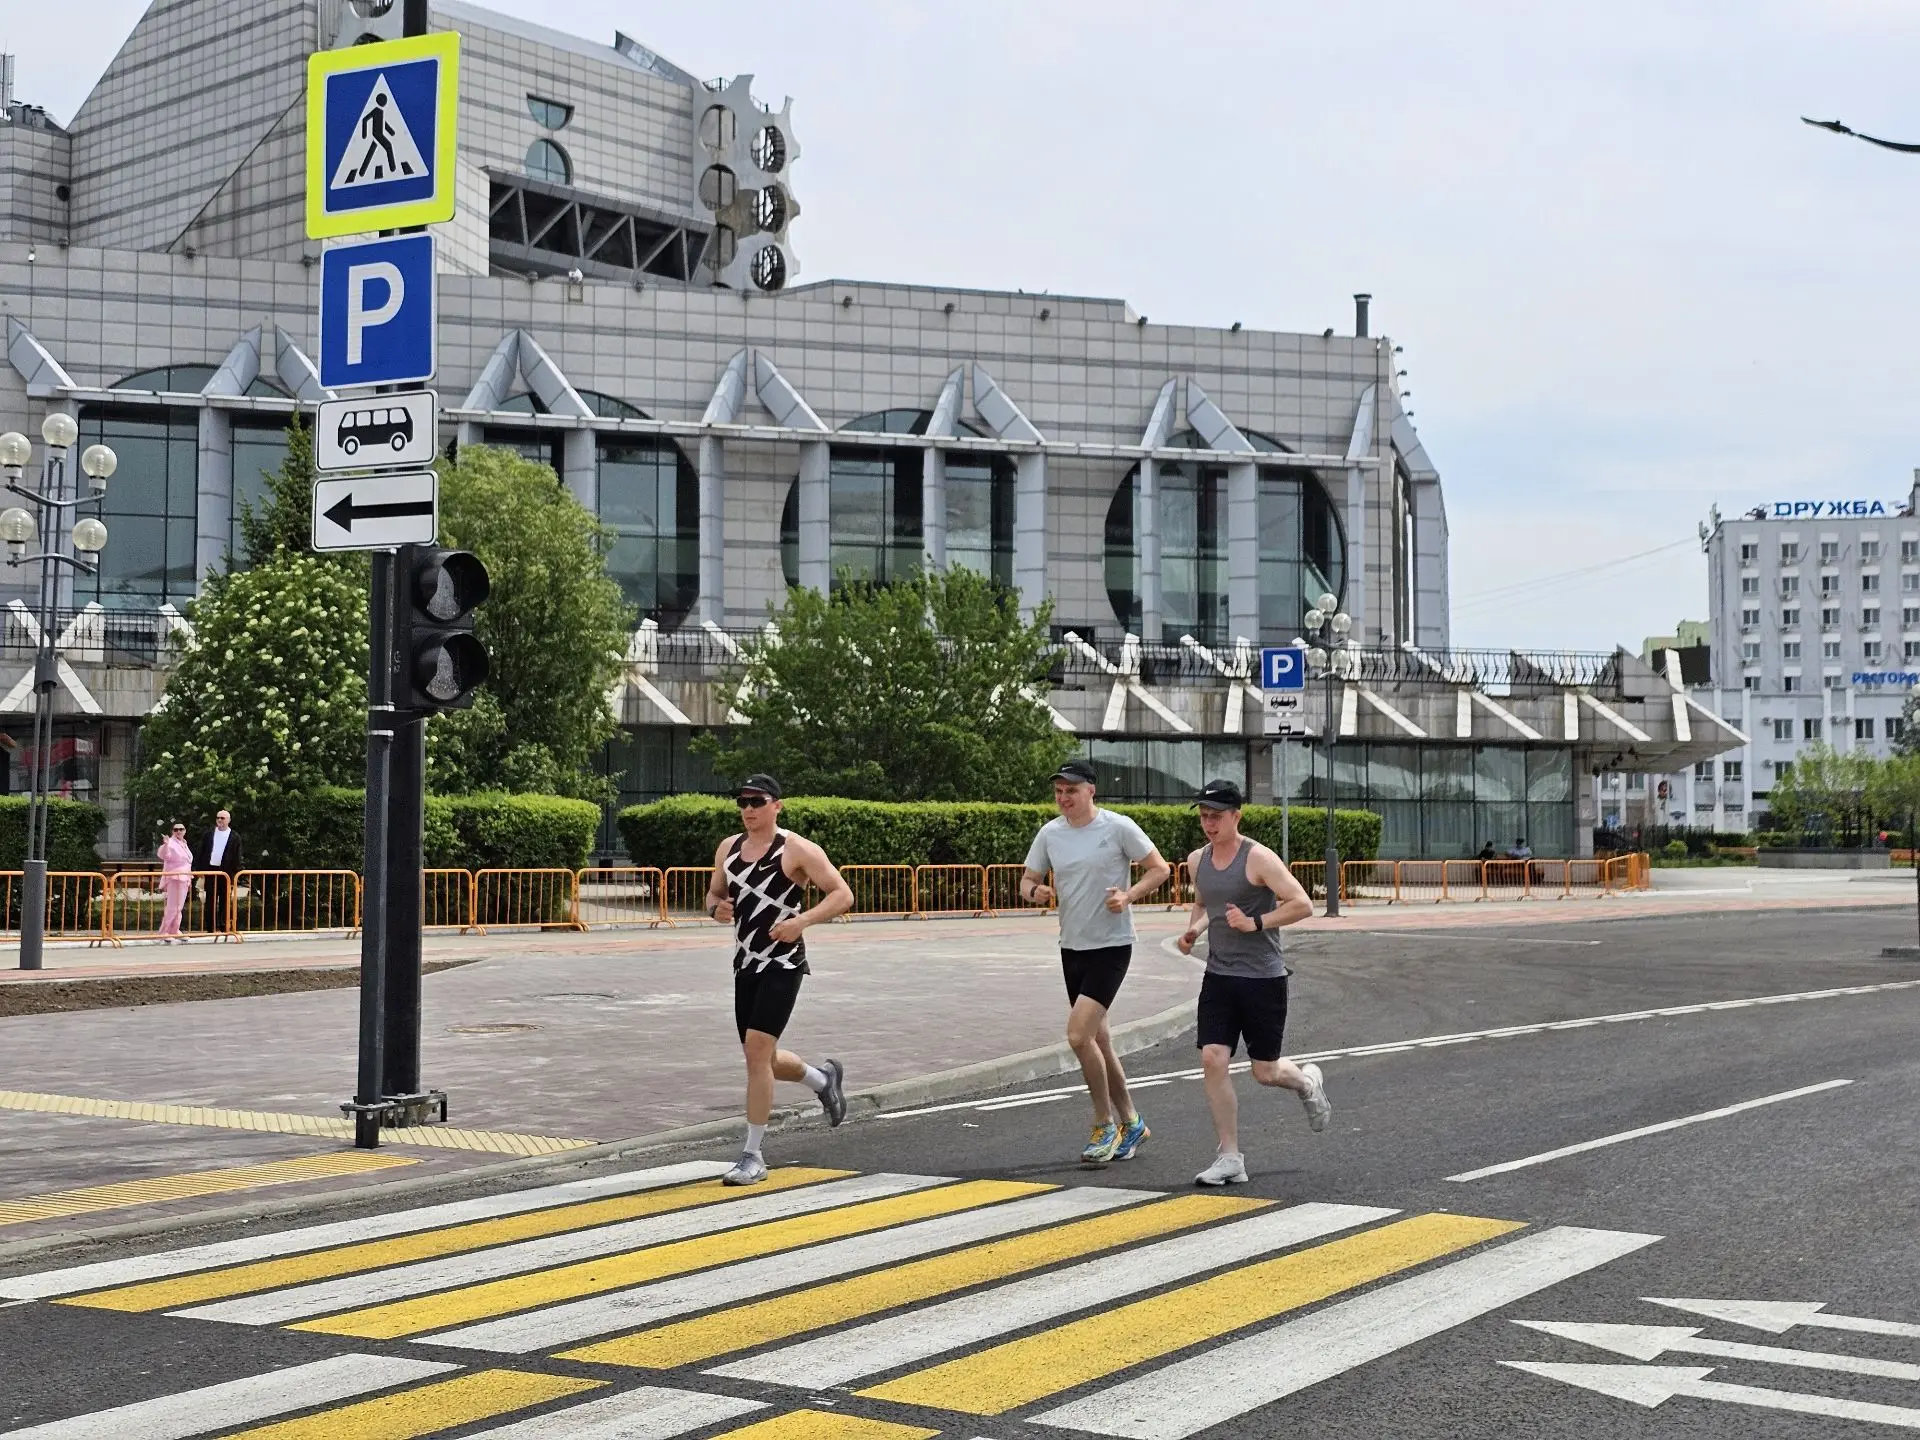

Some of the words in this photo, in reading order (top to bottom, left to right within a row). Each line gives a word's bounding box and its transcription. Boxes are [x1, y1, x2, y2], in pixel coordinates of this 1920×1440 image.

[347, 261, 405, 366] P
[1774, 500, 1885, 516] ДРУЖБА
[1272, 654, 1294, 684] P
[1852, 671, 1920, 685] РЕСТОРА
